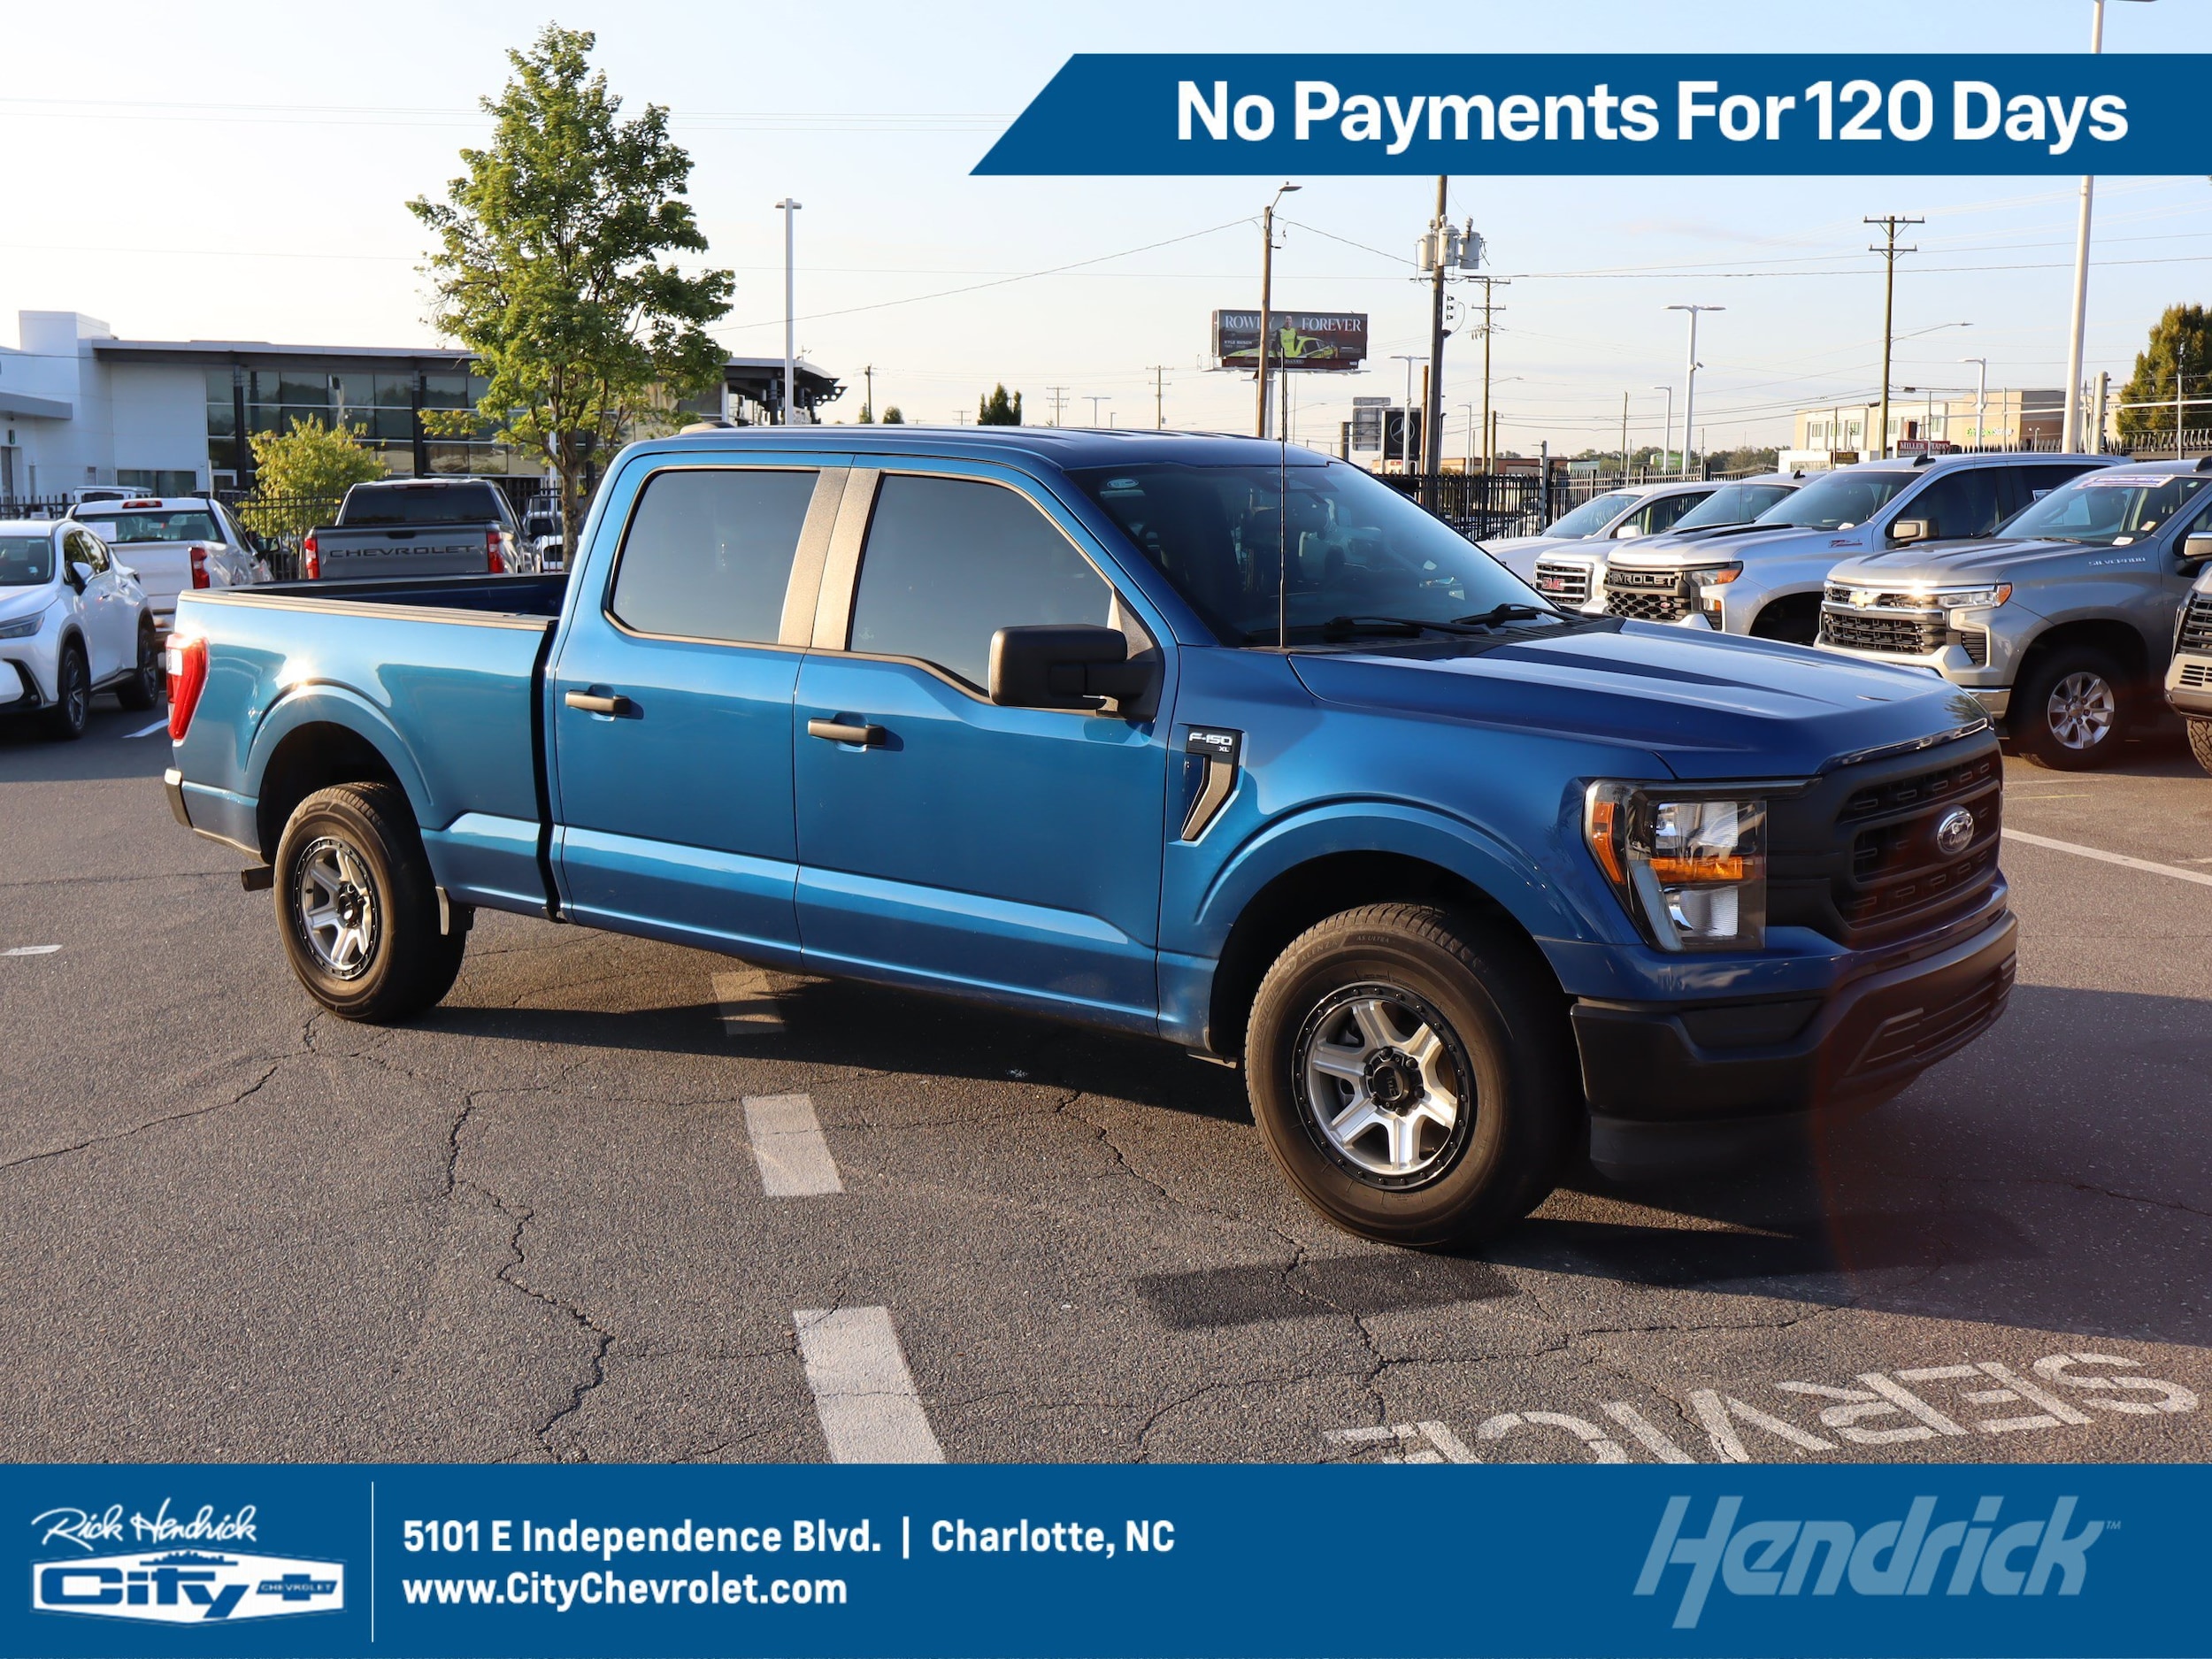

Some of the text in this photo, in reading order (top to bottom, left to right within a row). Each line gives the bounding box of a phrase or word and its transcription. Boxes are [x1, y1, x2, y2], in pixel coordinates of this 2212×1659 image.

[1225, 315, 1362, 332] ROWY FOREVER
[329, 545, 475, 557] CHEVROLET
[1541, 577, 1565, 591] GMC
[1604, 572, 1676, 587] HEVROLET
[1188, 732, 1233, 746] F-150
[1301, 940, 1339, 964] ALENZA
